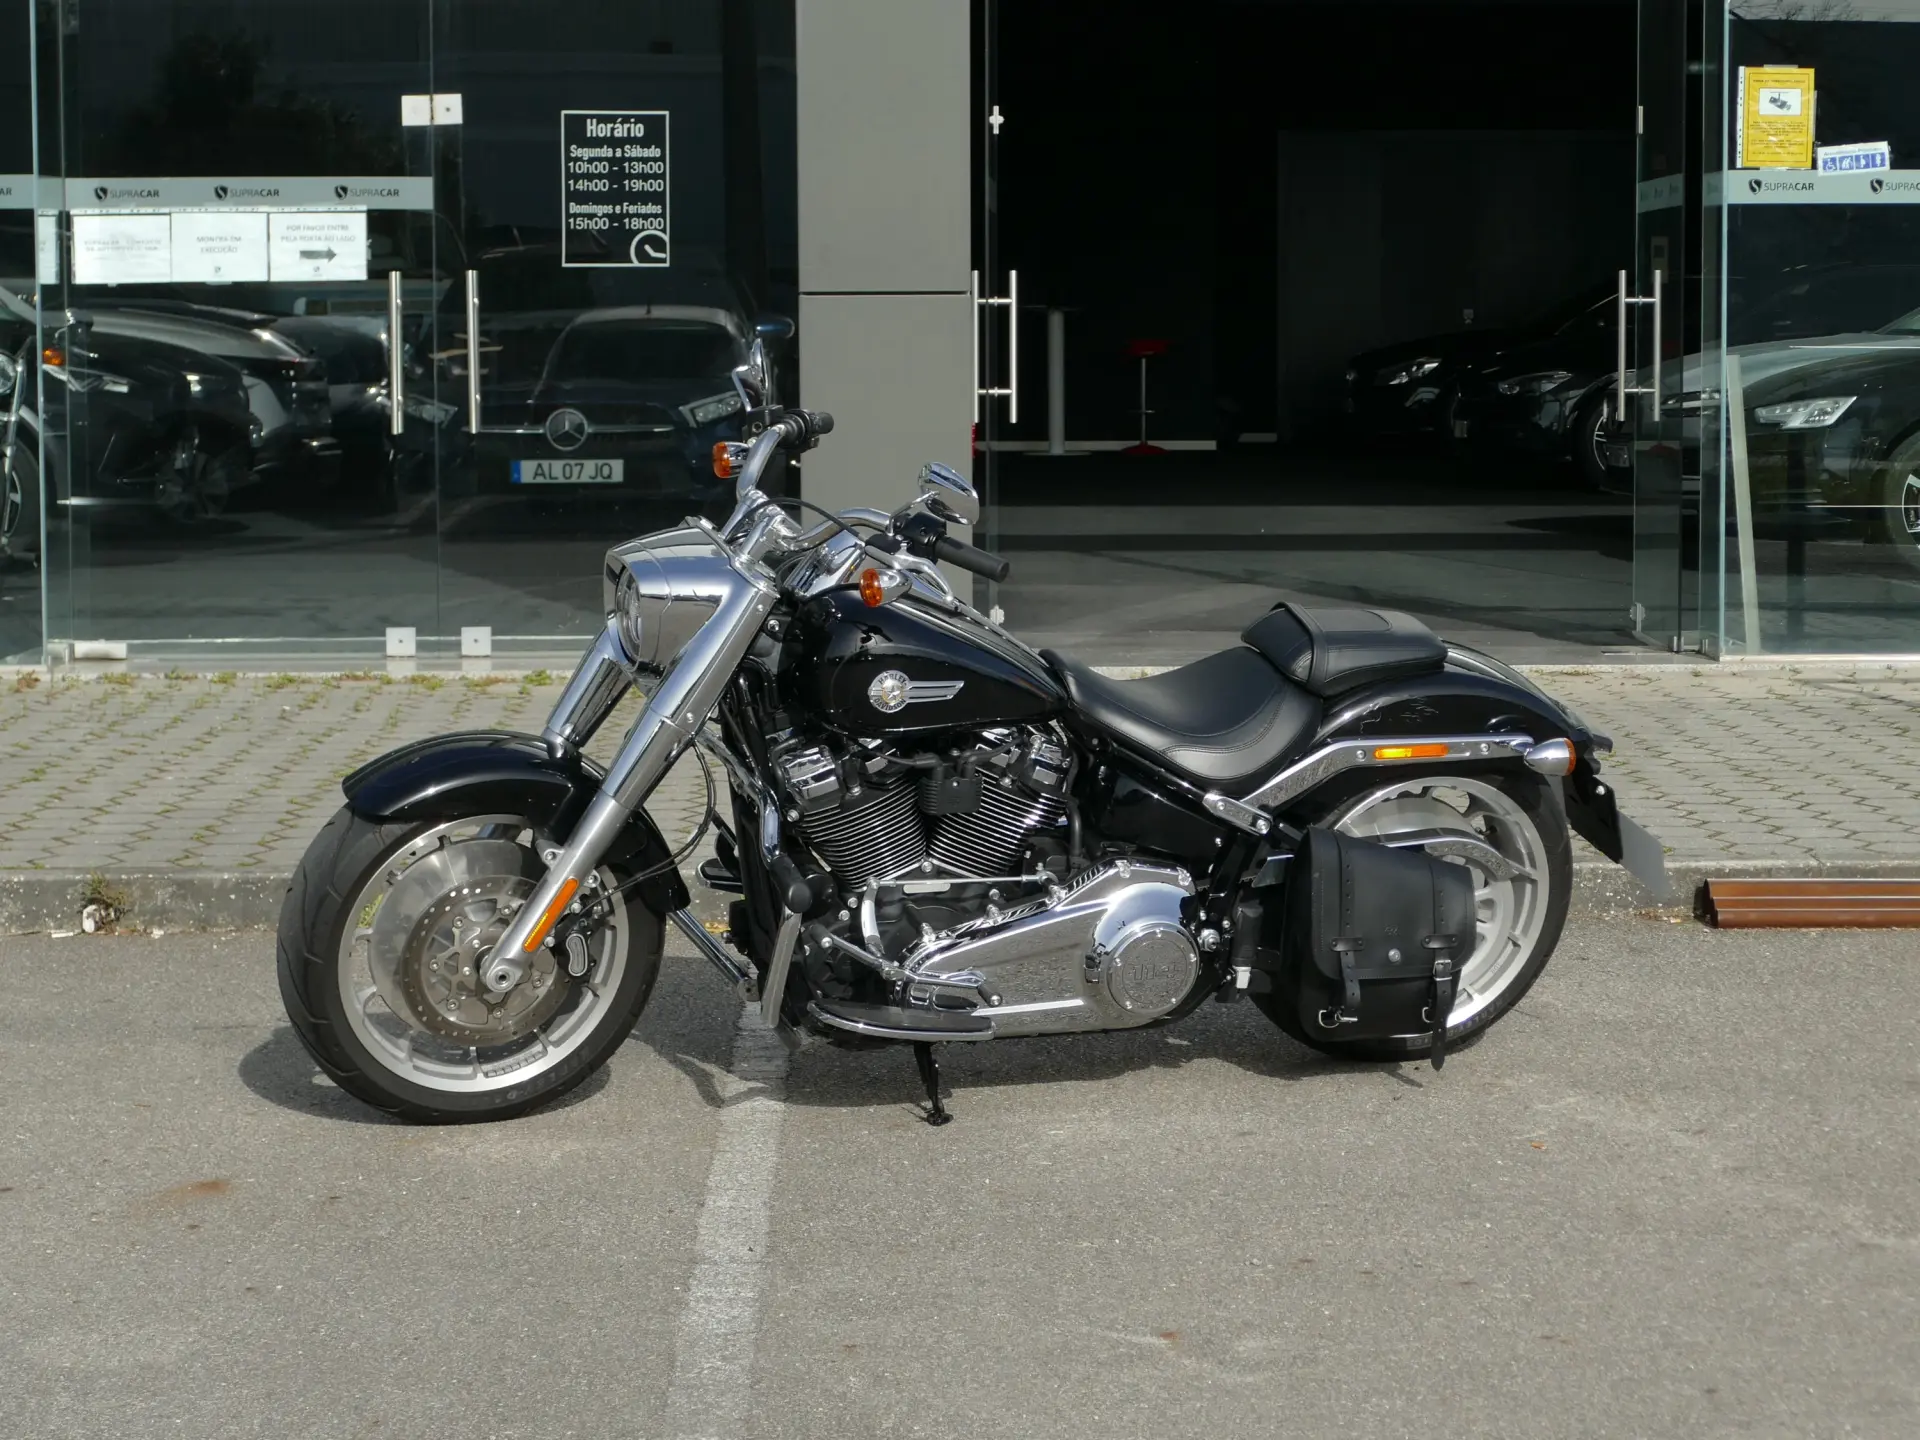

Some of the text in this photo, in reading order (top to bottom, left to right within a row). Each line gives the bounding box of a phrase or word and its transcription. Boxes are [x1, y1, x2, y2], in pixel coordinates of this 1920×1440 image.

[586, 117, 645, 138] Horário
[569, 144, 661, 160] Segunda a Sábado
[568, 161, 609, 174] 10h00
[623, 161, 664, 174] 13h00
[568, 179, 609, 191] 14h00
[623, 179, 664, 191] 19h00
[1764, 182, 1814, 191] SUPRACAR
[109, 189, 160, 198] SUPRACAR
[230, 188, 280, 197] SUPRACAR
[350, 188, 400, 197] SUPRACAR
[569, 202, 662, 217] Domingos e Feriados
[568, 217, 609, 230] 15h00
[623, 217, 664, 230] 18h00
[532, 462, 613, 480] AL 07 JQ
